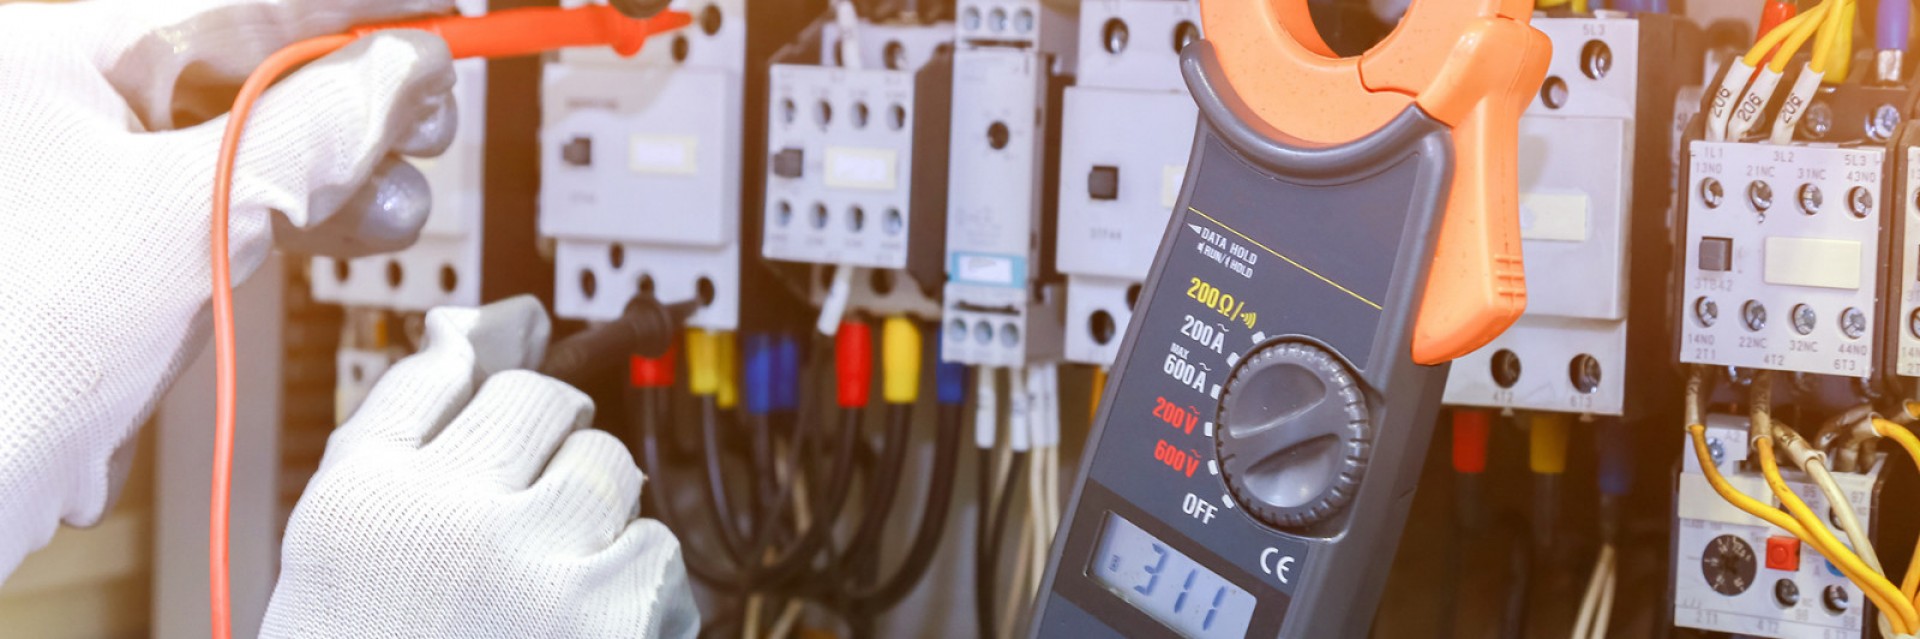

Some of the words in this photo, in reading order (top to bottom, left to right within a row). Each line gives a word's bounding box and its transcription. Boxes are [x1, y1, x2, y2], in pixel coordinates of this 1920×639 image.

[1714, 85, 1731, 118] 206
[1737, 93, 1763, 122] 206
[1782, 93, 1802, 124] 206
[1704, 147, 1723, 158] 1L1
[1773, 151, 1794, 163] 3L2
[1844, 154, 1867, 166] 5L3
[1746, 165, 1775, 178] 21NC
[1797, 168, 1827, 180] 31NC
[1201, 227, 1226, 249] DATA
[1229, 242, 1258, 265] HOLD
[1230, 259, 1254, 279] HOLD
[1170, 342, 1190, 360] MAX
[1738, 336, 1768, 349] 22NC
[1789, 340, 1818, 353] 32NC
[1695, 348, 1716, 360] 2T1
[1763, 354, 1785, 366] 4T2
[1834, 359, 1856, 371] 6T3
[1182, 492, 1219, 525] OFF
[1259, 547, 1295, 584] CE
[1134, 543, 1227, 631] 311
